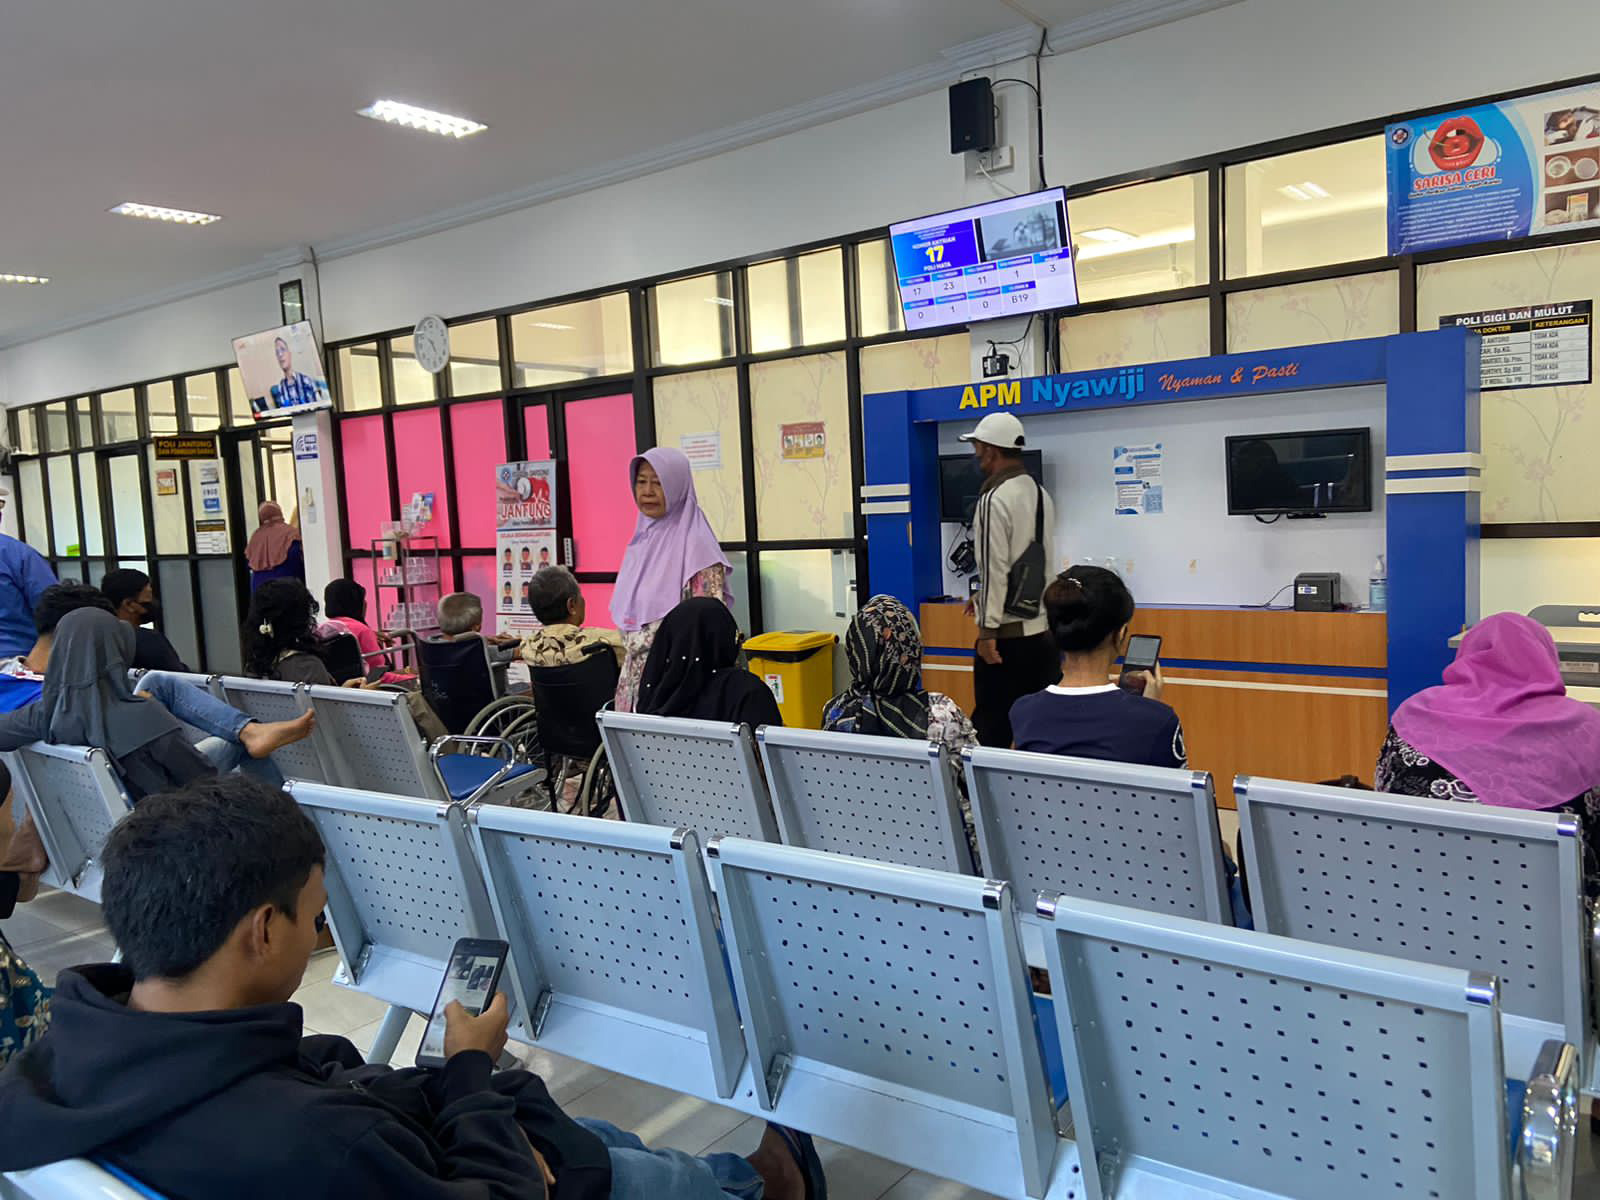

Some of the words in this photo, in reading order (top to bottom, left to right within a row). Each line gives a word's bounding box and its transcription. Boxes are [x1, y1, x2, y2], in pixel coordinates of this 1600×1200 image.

[1464, 166, 1496, 182] CERI
[925, 245, 944, 262] 17
[1049, 264, 1057, 273] 3
[978, 276, 987, 285] 11
[943, 281, 955, 291] 23
[913, 287, 921, 296] 17
[982, 300, 989, 309] 0
[917, 310, 924, 319] 0
[1456, 315, 1481, 326] POLI
[1483, 312, 1506, 323] GIGI
[1509, 311, 1531, 320] DAN
[1534, 305, 1574, 318] MULUT
[1535, 317, 1585, 328] KETERANGAN
[1483, 325, 1512, 334] DOKTER
[1158, 373, 1222, 391] Nyaman
[1230, 367, 1243, 383] &
[1252, 362, 1301, 384] Pasti
[959, 381, 1021, 410] APM
[1032, 368, 1146, 407] Nyawiji
[502, 502, 552, 519] JANTUNG
